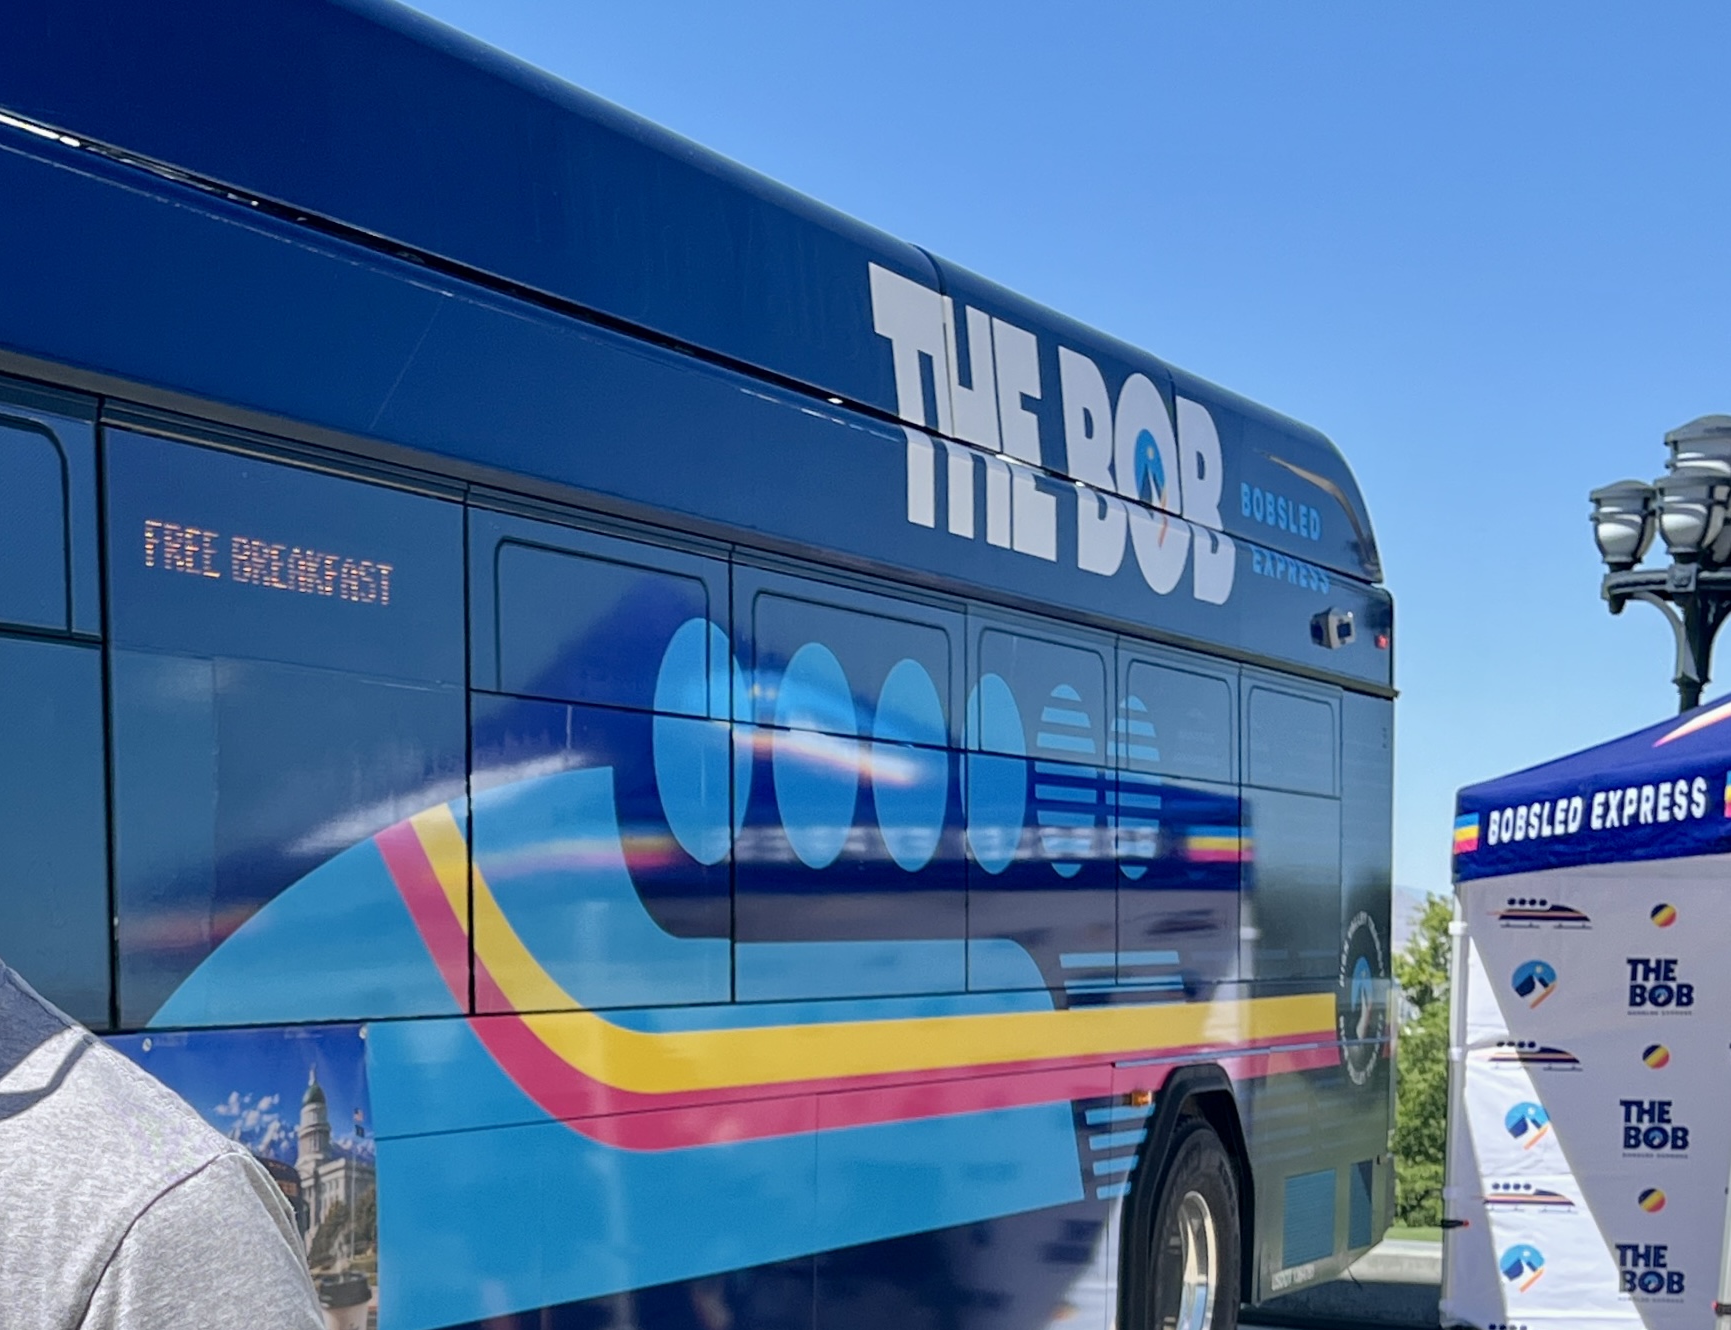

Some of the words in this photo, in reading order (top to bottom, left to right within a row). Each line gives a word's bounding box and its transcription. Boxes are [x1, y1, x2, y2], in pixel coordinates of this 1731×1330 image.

[868, 262, 1057, 562] THE
[1058, 346, 1236, 606] BOB
[1241, 482, 1321, 541] BOBSLED
[145, 520, 220, 578] FREE
[232, 537, 393, 605] BREAKFAST
[1249, 544, 1330, 595] EXPRESS
[1487, 796, 1583, 846] BOBSLED
[1591, 776, 1707, 830] EXPRESS
[1626, 957, 1678, 982] THE
[1629, 983, 1694, 1007] BOB
[1619, 1099, 1672, 1124] THE
[1624, 1126, 1689, 1150] BOB
[1615, 1243, 1668, 1268] THE
[1619, 1270, 1685, 1294] BOB
